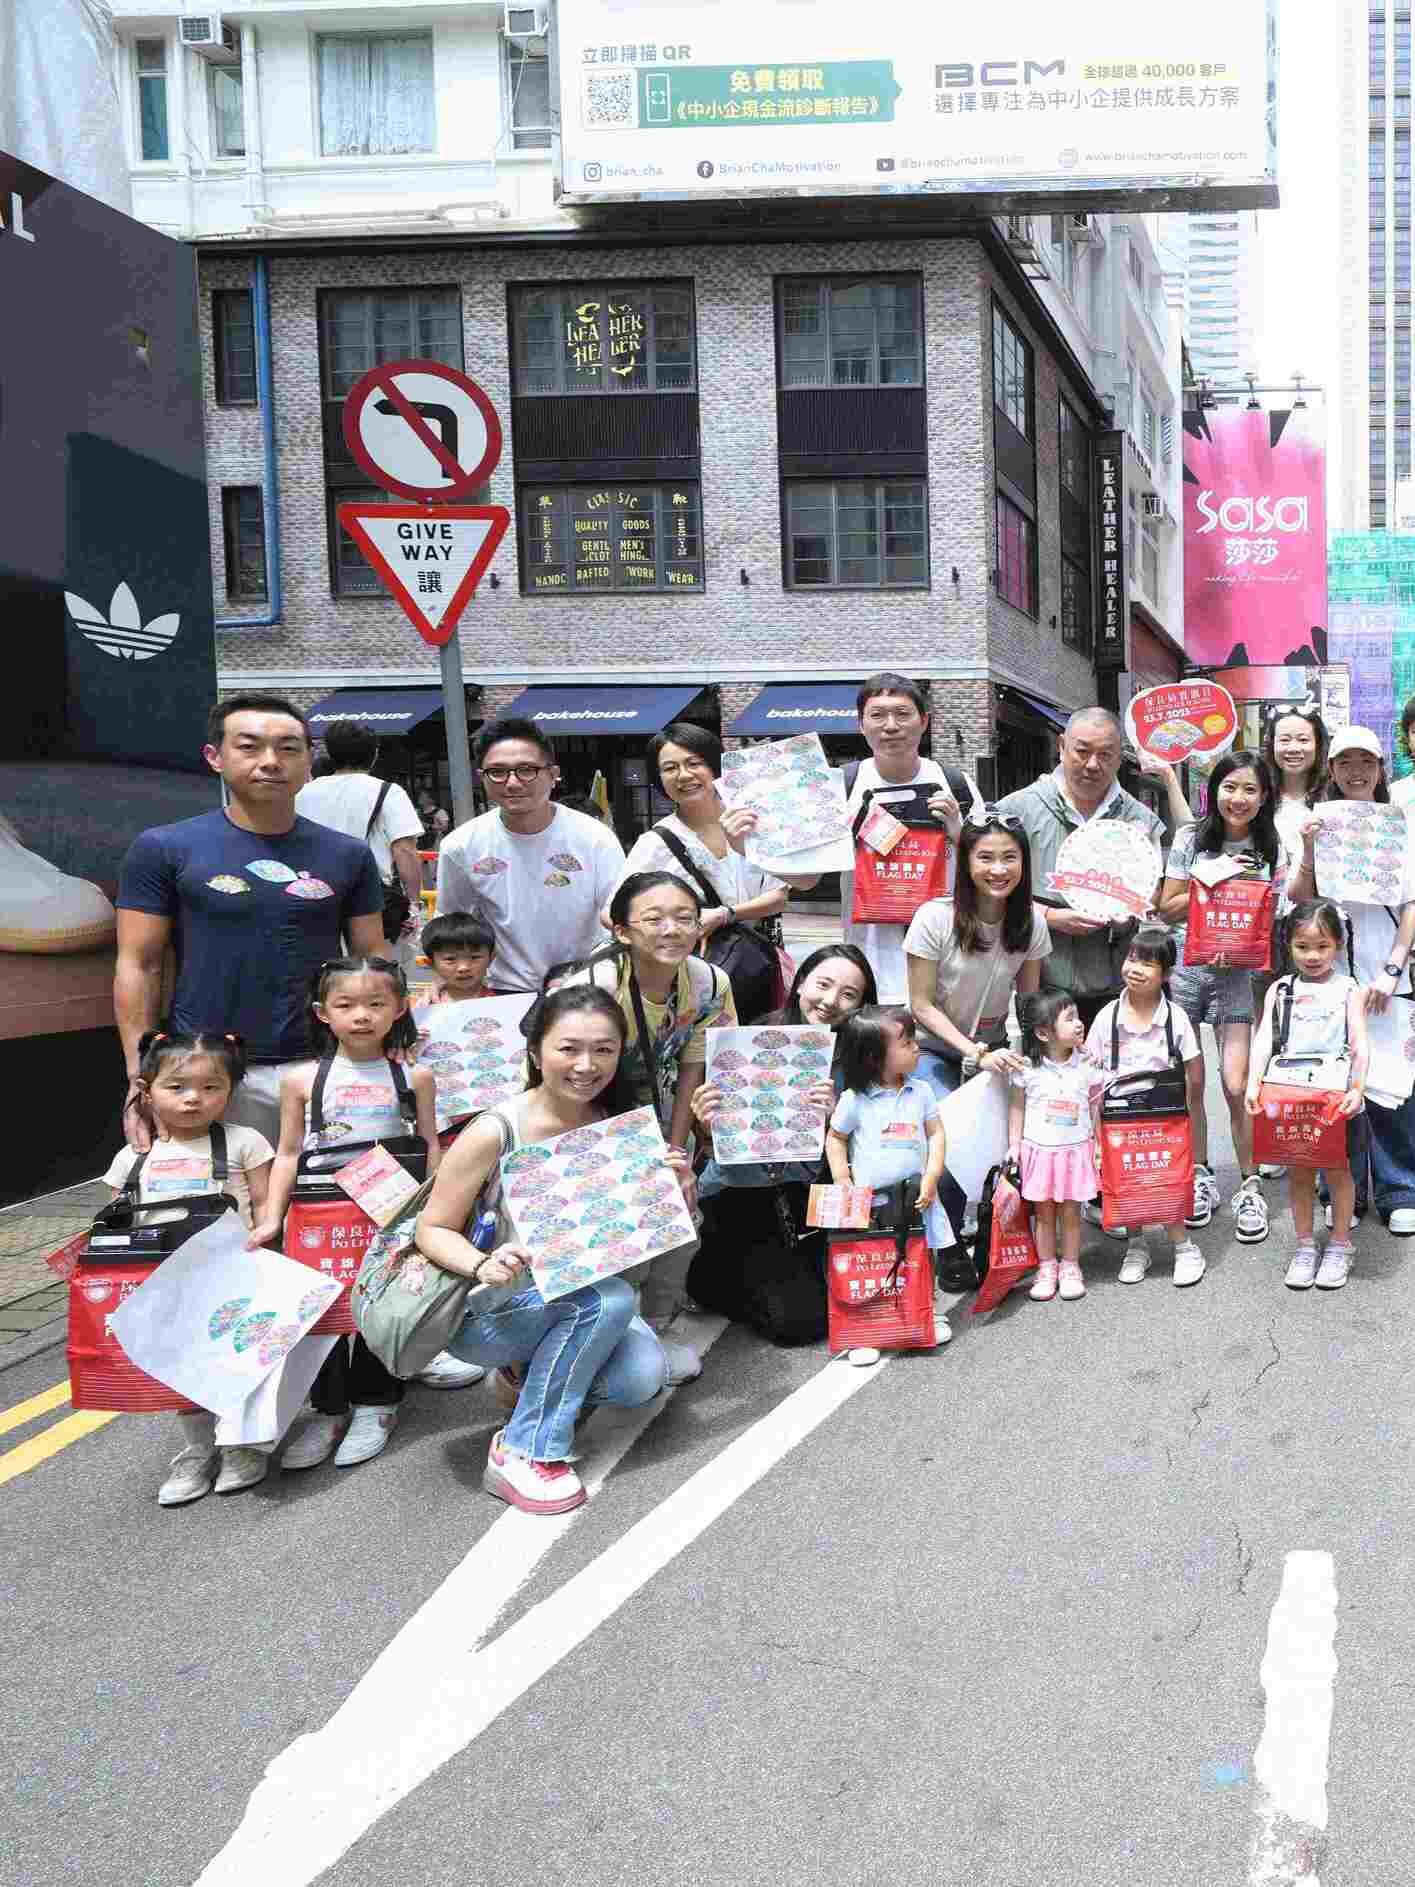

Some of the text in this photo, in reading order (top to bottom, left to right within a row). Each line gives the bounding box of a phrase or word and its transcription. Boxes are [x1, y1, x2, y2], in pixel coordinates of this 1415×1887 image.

[662, 45, 692, 61] QR
[935, 60, 1065, 88] BCM
[1141, 63, 1195, 79] 40,000
[397, 523, 454, 540] GIVE
[622, 519, 650, 530] GOODS
[401, 544, 454, 561] WAY
[1103, 459, 1118, 639] LEATHER HEALER
[1224, 538, 1280, 566] 莎莎
[416, 568, 443, 593] 讓
[310, 711, 412, 723] bakehouse
[533, 709, 638, 721] bakehouse
[1206, 920, 1249, 928] FLAG DAY
[1123, 1159, 1170, 1170] FLAG DAY
[850, 1287, 904, 1299] FLAG DAY
